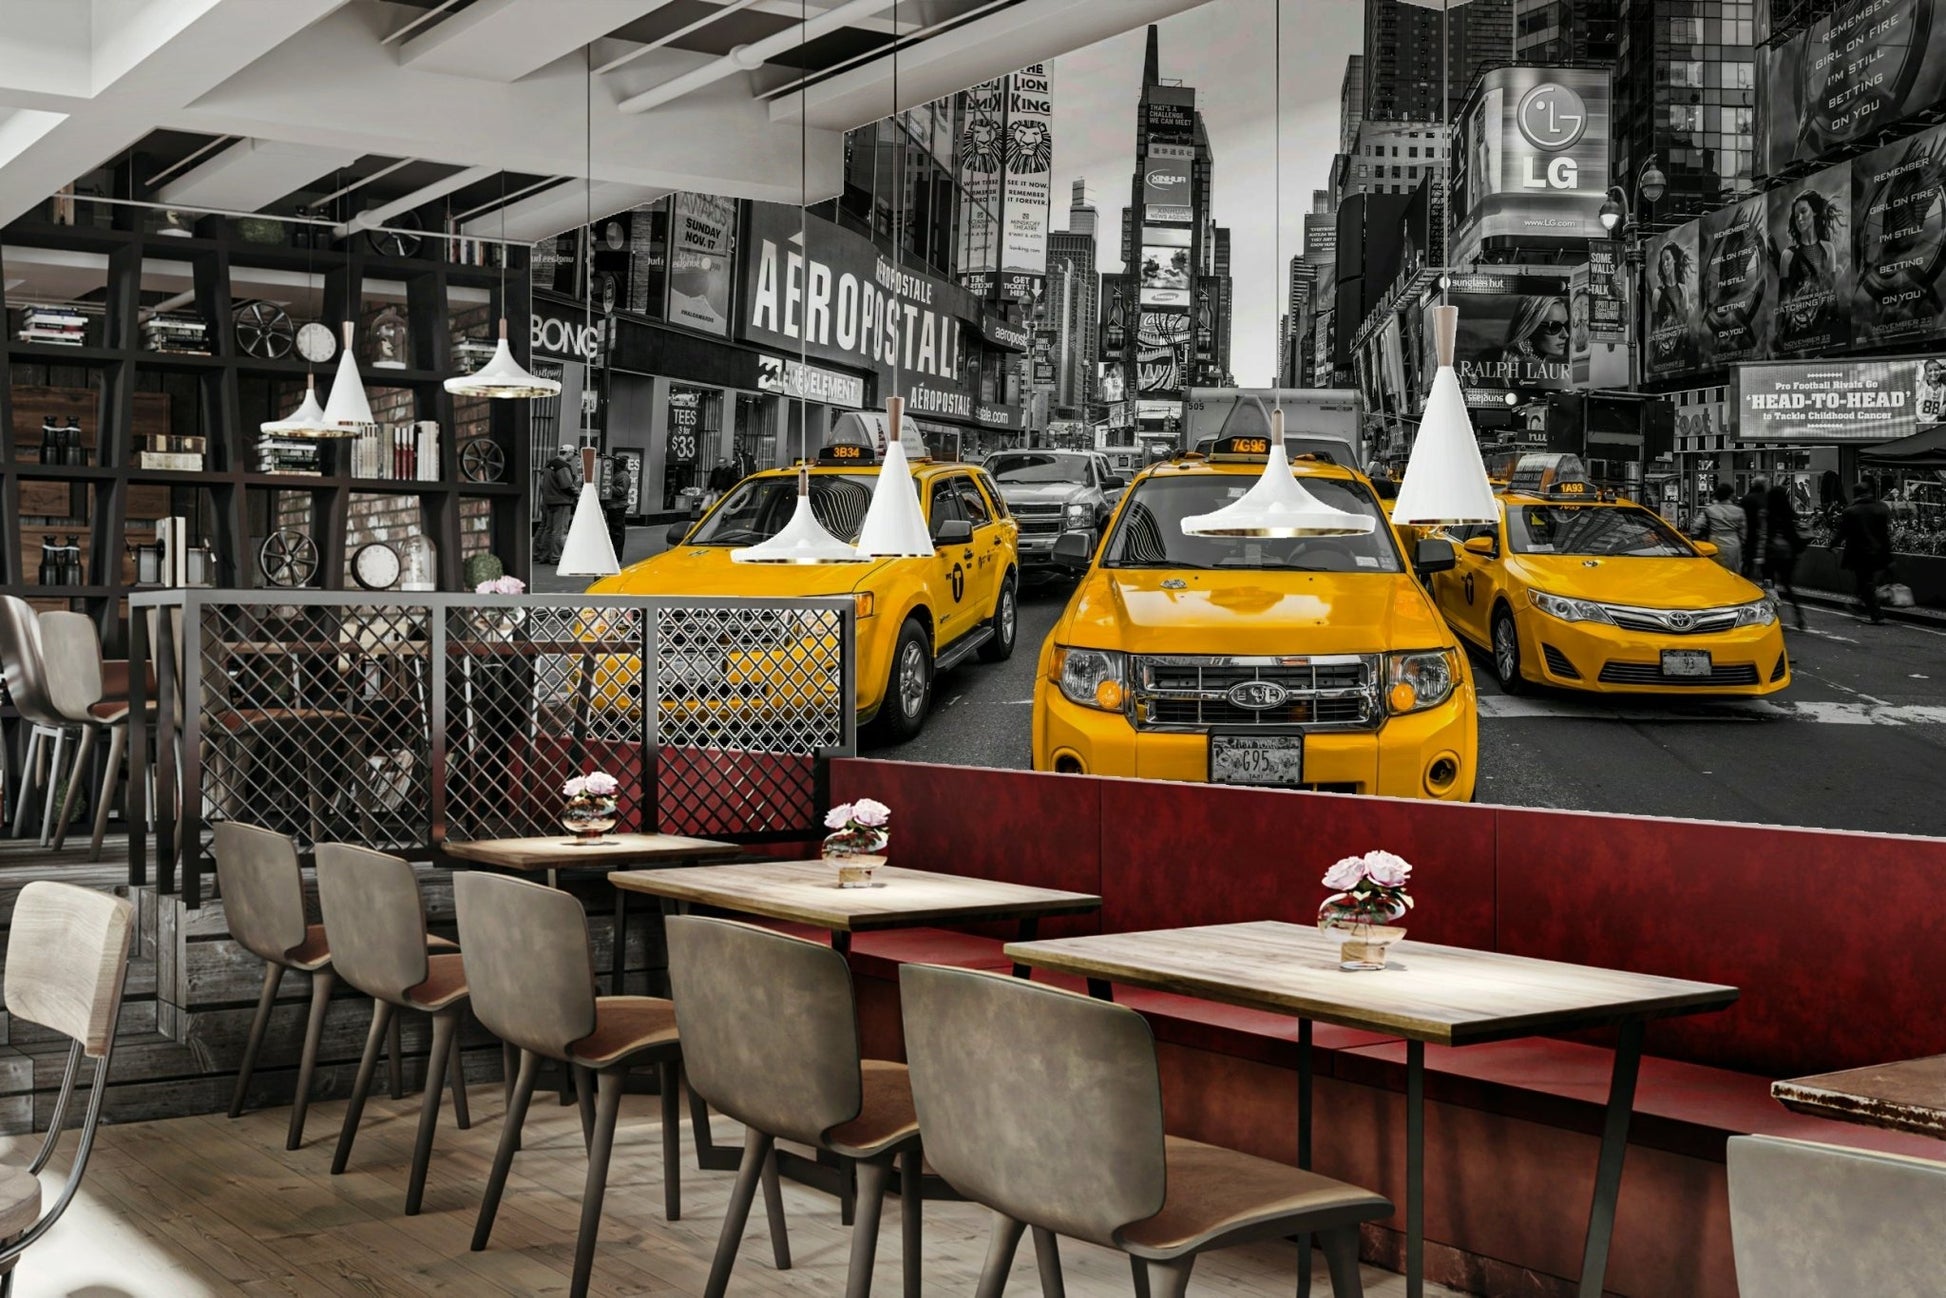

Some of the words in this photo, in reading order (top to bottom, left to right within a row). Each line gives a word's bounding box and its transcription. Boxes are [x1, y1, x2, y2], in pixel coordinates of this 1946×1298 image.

[1816, 49, 1842, 70] GIRL
[1846, 34, 1864, 52] ON
[1869, 14, 1899, 39] FIRE
[1021, 64, 1044, 75] HE
[1828, 70, 1844, 86] I'M
[1848, 49, 1884, 75] STILL
[1014, 74, 1048, 92] LION
[1828, 73, 1884, 109] BETTING
[1011, 93, 1051, 113] KING
[1149, 111, 1184, 119] CHALLENGE
[1832, 114, 1849, 130] ON
[1853, 99, 1880, 119] YOU
[1522, 156, 1578, 189] LG
[1874, 157, 1930, 183] REMEMBER
[1008, 190, 1045, 198] REMEMBER
[1015, 198, 1048, 206] FOREVER.
[1869, 203, 1892, 216] GIRL
[1893, 198, 1909, 208] ON
[1911, 189, 1935, 202] FIRE
[1157, 207, 1185, 215] XINHUA
[685, 217, 721, 240] SUNDAY
[1524, 218, 1576, 227] www.LG.com
[1713, 222, 1751, 240] REMEMBER
[1879, 233, 1893, 243] I'M
[1895, 225, 1924, 239] STILL
[685, 231, 706, 248] NOV.
[707, 239, 716, 250] 17
[1590, 252, 1613, 263] SOME
[1711, 256, 1726, 265] GIRL
[1590, 263, 1616, 274] WALLS
[1879, 257, 1924, 275] BETTING
[1012, 276, 1031, 285] GET
[1452, 278, 1488, 290] sunglass
[1488, 278, 1504, 289] hut
[1591, 274, 1606, 284] CAN
[1718, 281, 1727, 289] I'M
[1728, 275, 1746, 286] STILL
[1590, 284, 1609, 295] TALK
[1882, 295, 1898, 306] ON
[1899, 290, 1921, 302] YOU
[1717, 301, 1746, 313] BETTING
[1773, 298, 1819, 316] CATCHING
[1718, 329, 1730, 338] ON
[1729, 328, 1744, 337] YOU
[1460, 360, 1520, 379] RALPH
[811, 370, 857, 402] ELEMENT
[1775, 382, 1791, 391] Pro
[1793, 381, 1830, 390] Football
[1832, 380, 1863, 389] Rivals
[1866, 380, 1878, 389] Go
[1188, 402, 1205, 411] 505
[1922, 399, 1941, 415] 88
[673, 408, 697, 426] TEES
[1763, 412, 1772, 420] to
[1774, 412, 1806, 420] Tackle
[1808, 411, 1855, 420] Childhood
[1857, 411, 1893, 420] Cancer
[671, 435, 696, 458] $33
[832, 446, 861, 459] 3B34
[1232, 438, 1267, 452] 7G95
[1560, 483, 1584, 493] 1A93
[1242, 749, 1270, 772] G95
